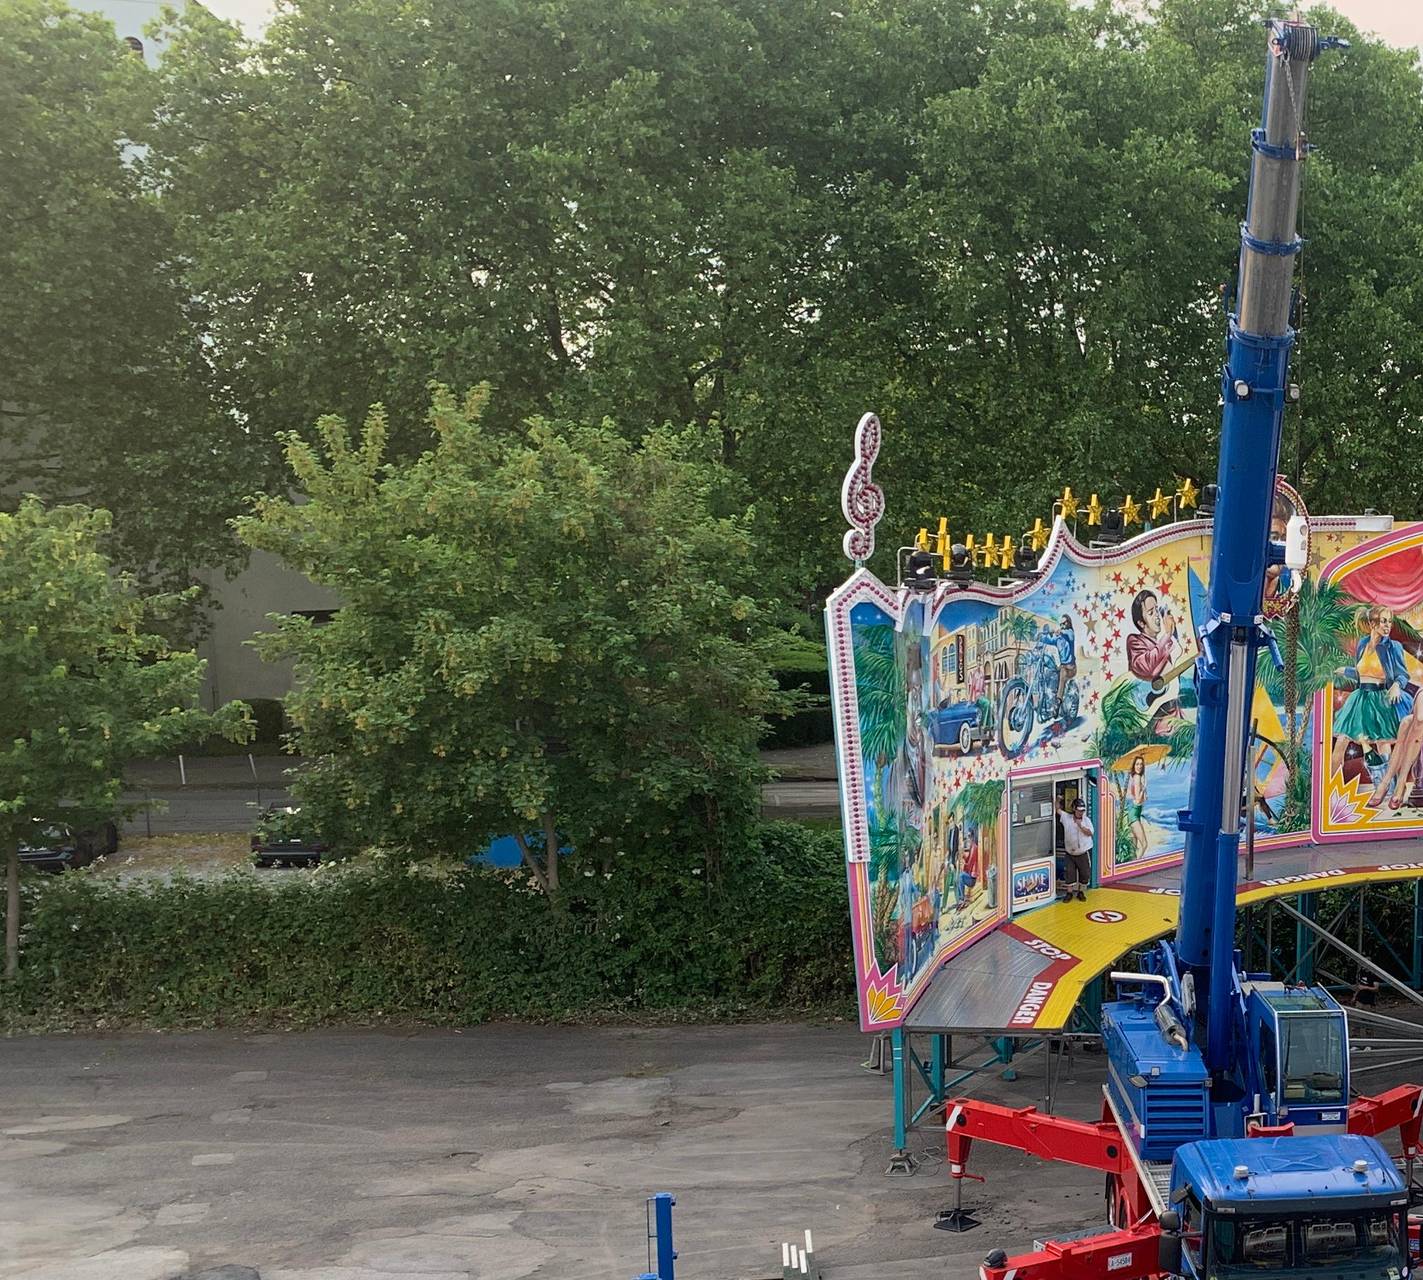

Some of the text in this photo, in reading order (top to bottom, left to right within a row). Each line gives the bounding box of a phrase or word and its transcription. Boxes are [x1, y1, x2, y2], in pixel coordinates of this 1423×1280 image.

[1259, 869, 1347, 887] DANGER
[1148, 887, 1181, 897] OP
[1023, 939, 1072, 960] STOP
[1011, 981, 1053, 1024] DANGER
